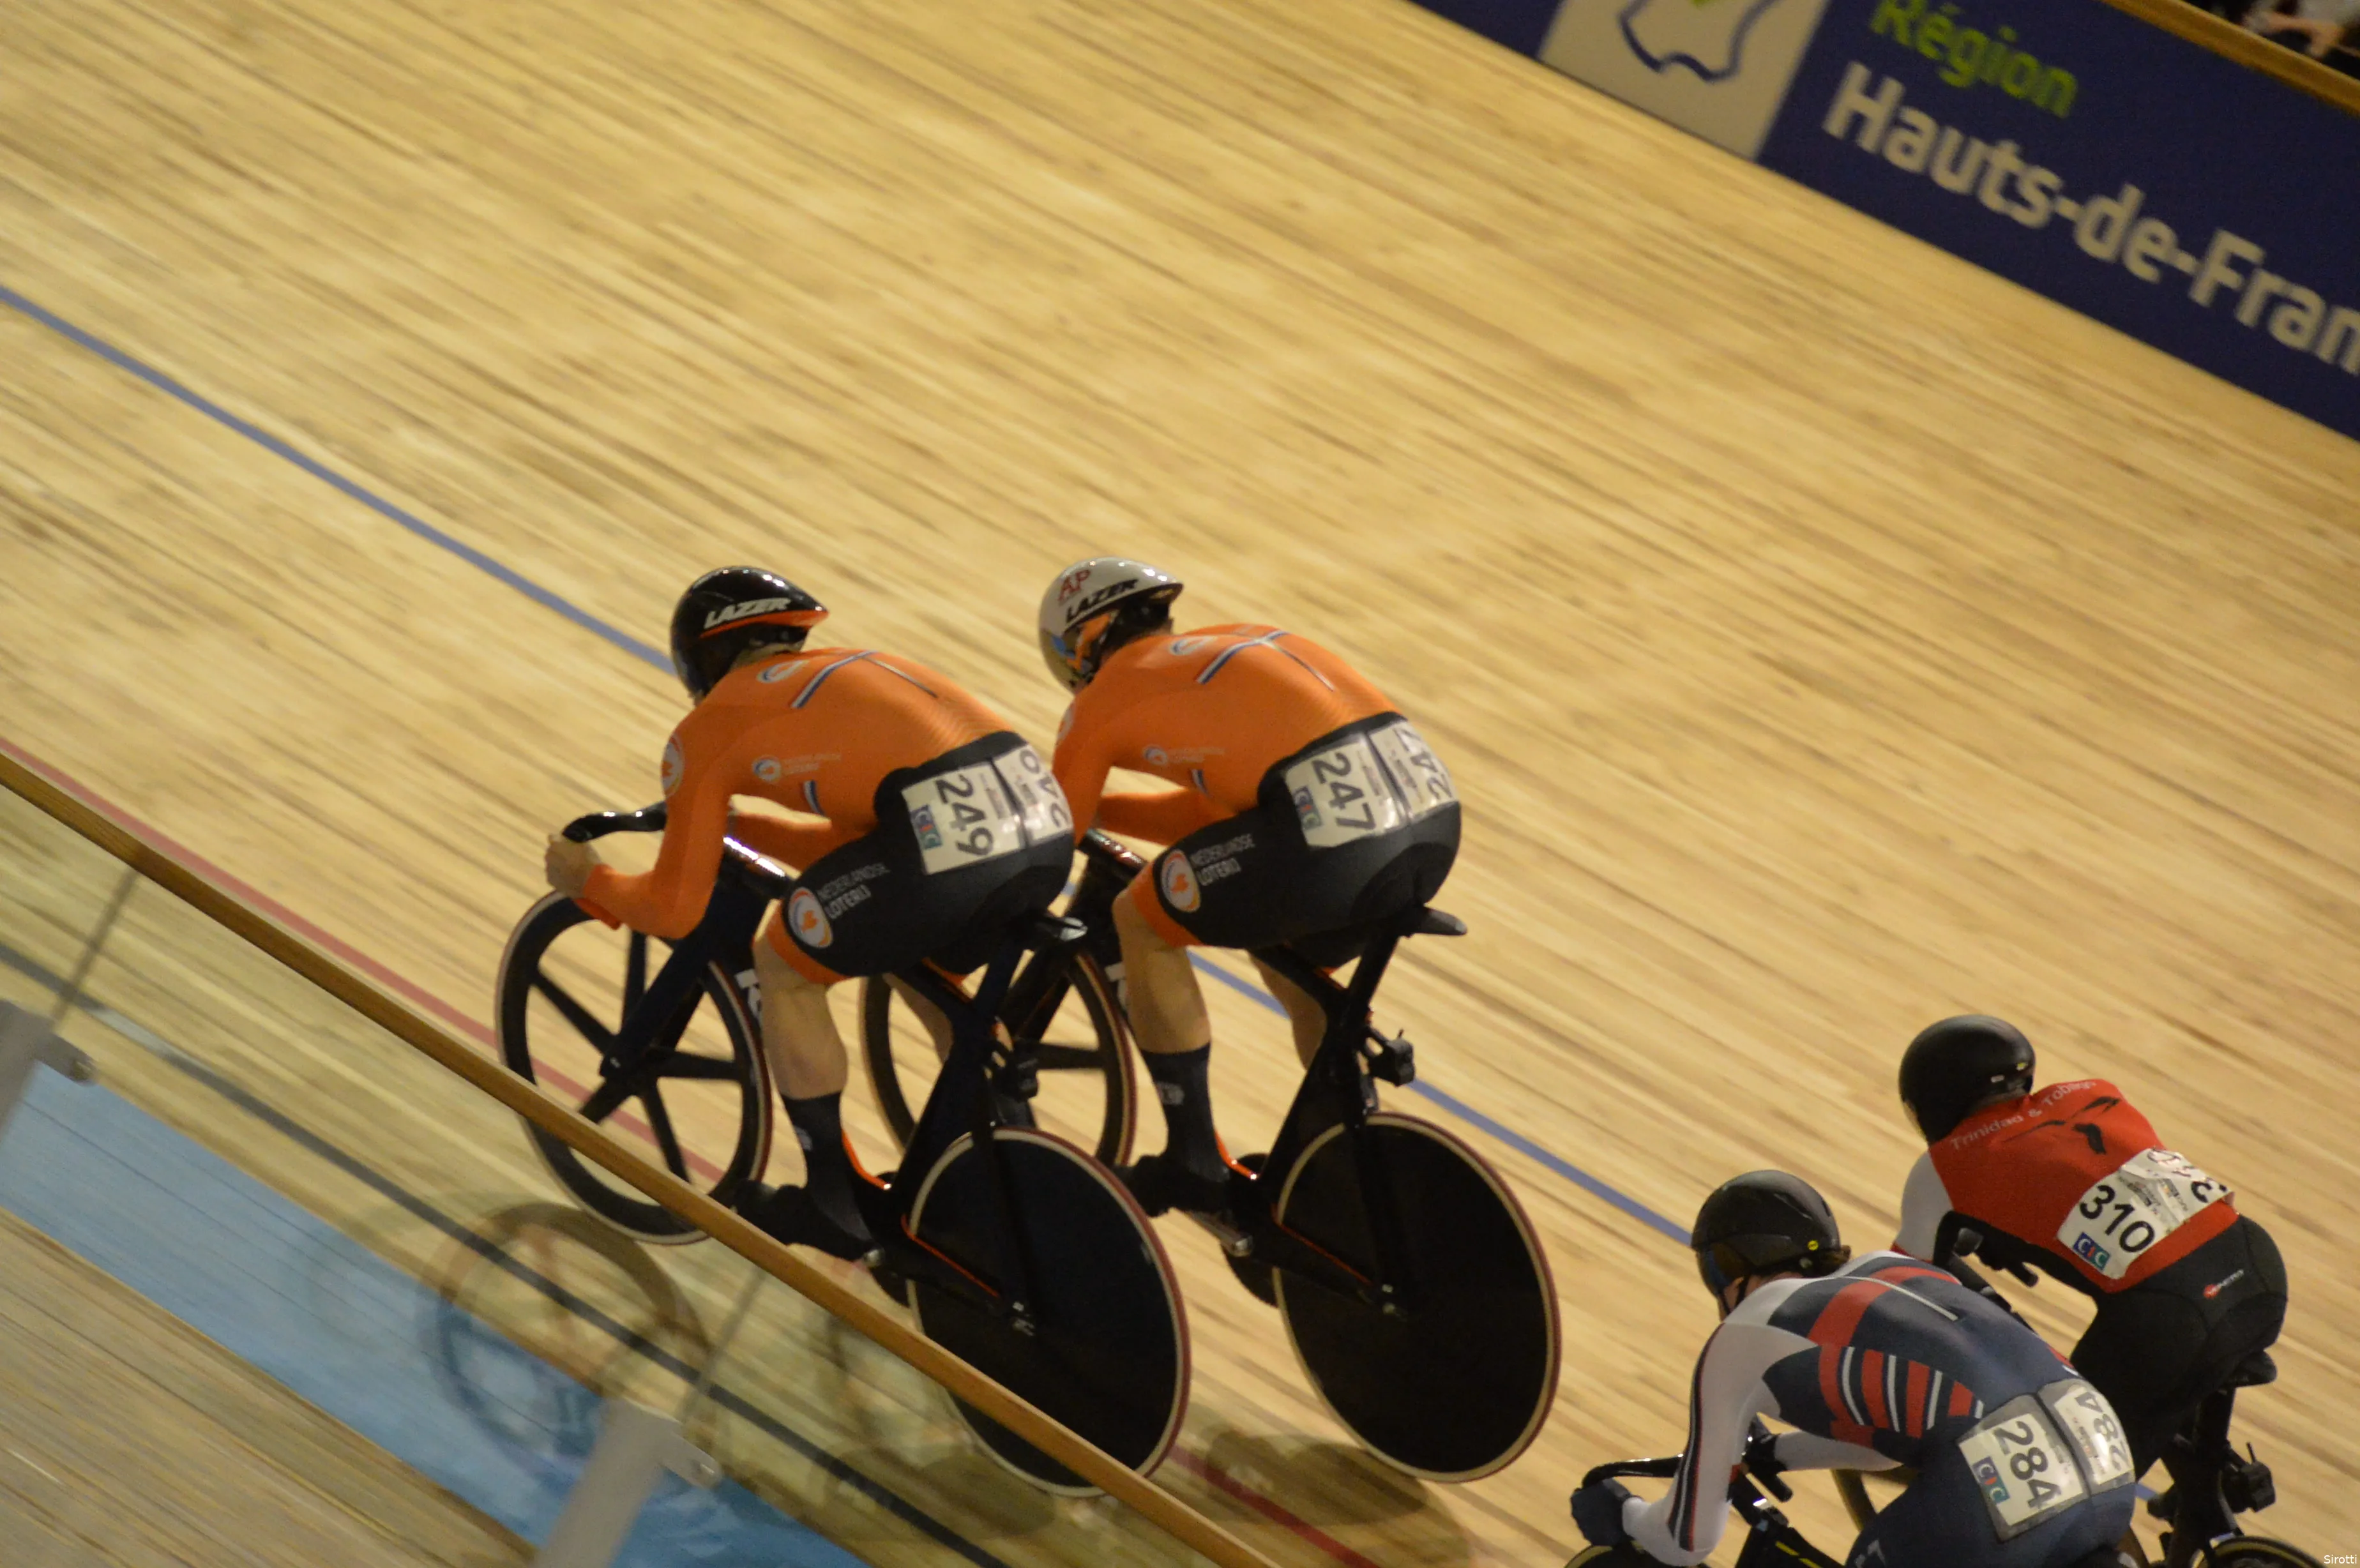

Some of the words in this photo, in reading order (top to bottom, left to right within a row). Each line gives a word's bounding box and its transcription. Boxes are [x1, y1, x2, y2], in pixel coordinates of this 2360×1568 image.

[1869, 0, 2078, 119] Région
[704, 598, 792, 629] LAZER
[1066, 578, 1138, 623] LAZER
[935, 774, 994, 856] 249
[1312, 752, 1377, 830] 247
[2027, 1108, 2043, 1119] &
[2079, 1184, 2154, 1253] 310
[2077, 1237, 2108, 1267] CIC
[1979, 1463, 2006, 1500] CIC
[1993, 1421, 2062, 1509] 284
